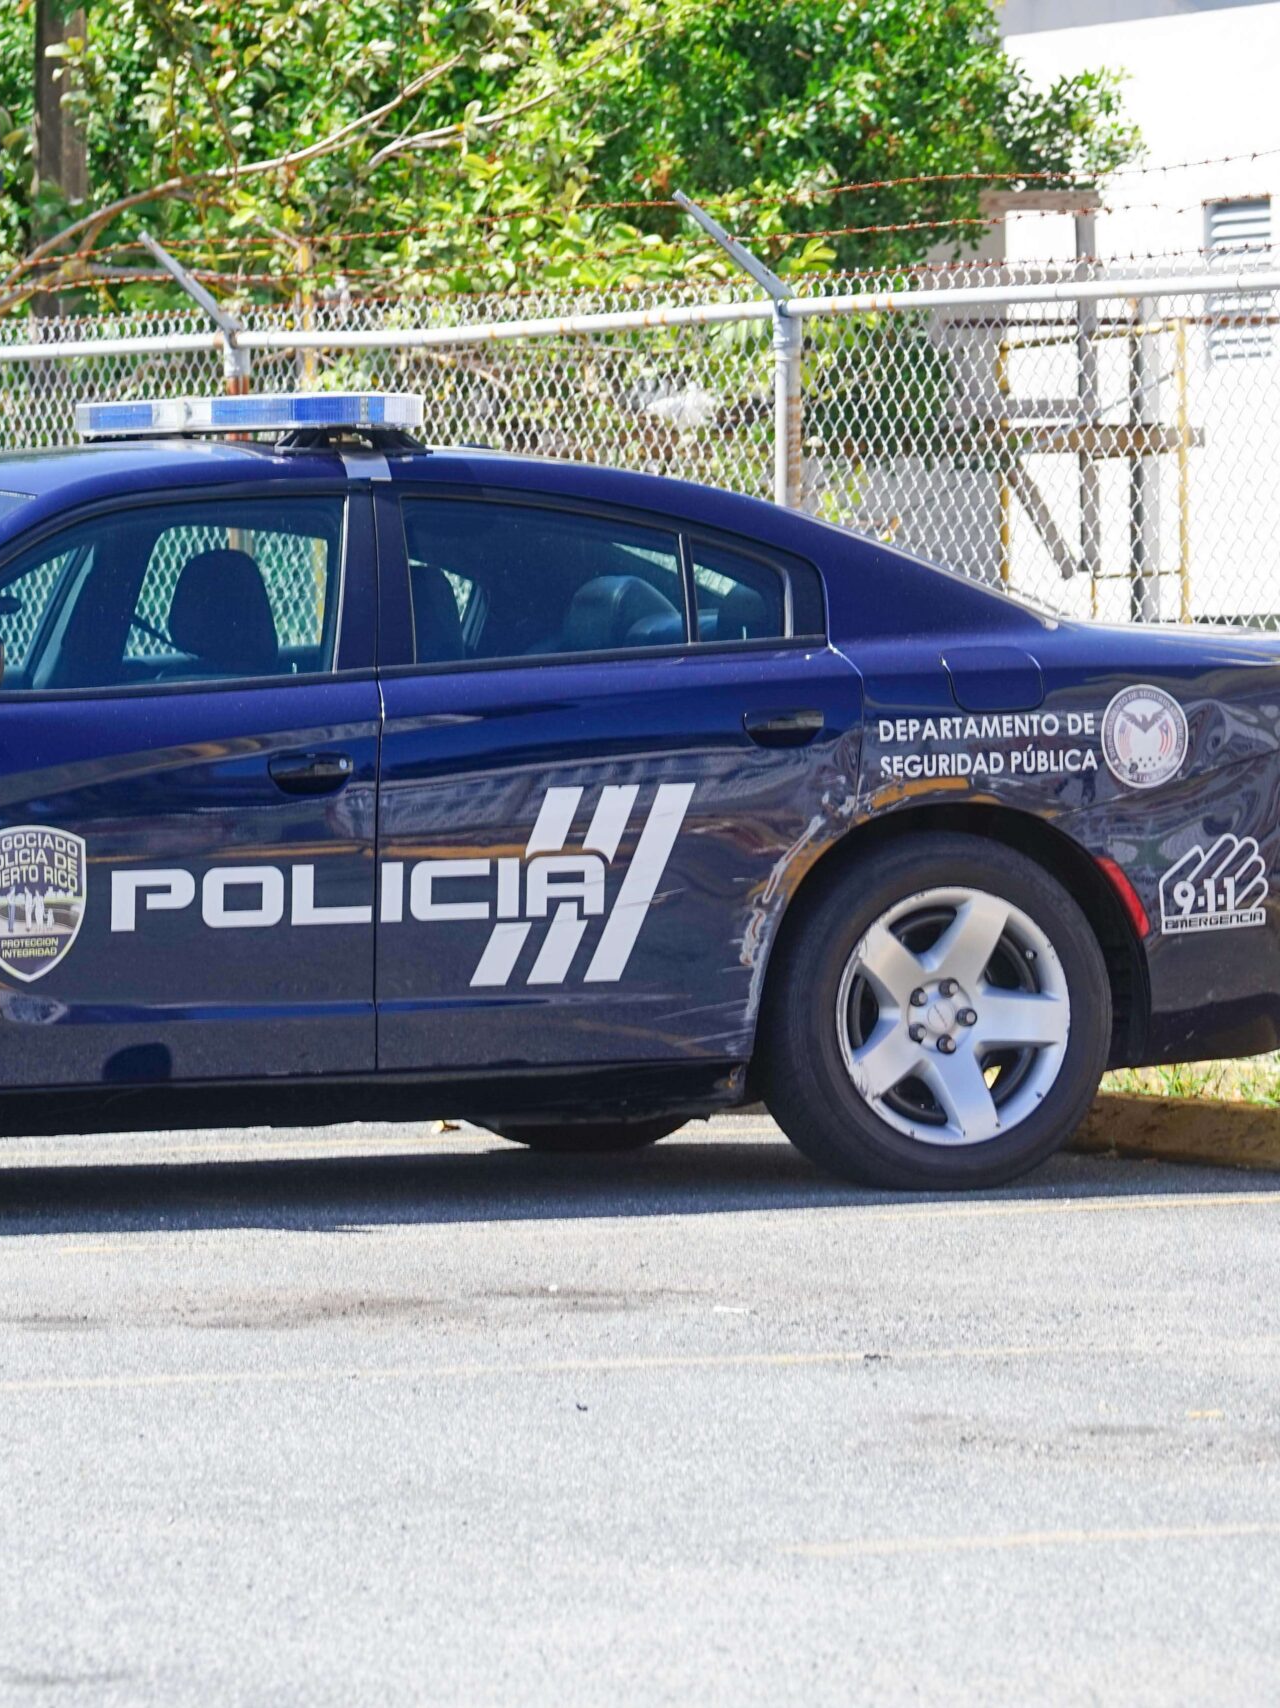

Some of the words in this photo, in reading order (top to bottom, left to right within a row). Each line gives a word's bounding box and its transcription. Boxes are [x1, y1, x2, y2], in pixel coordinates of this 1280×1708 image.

[879, 714, 1059, 742] DEPARTAMENTO
[1067, 712, 1095, 735] DE
[880, 751, 1004, 778] SEGURIDAD
[1010, 744, 1098, 773] PÚBLICA
[53, 851, 78, 876] DE
[44, 865, 78, 893] RICO
[111, 855, 604, 932] POLICIA
[2, 946, 58, 959] INTEGRIDAD
